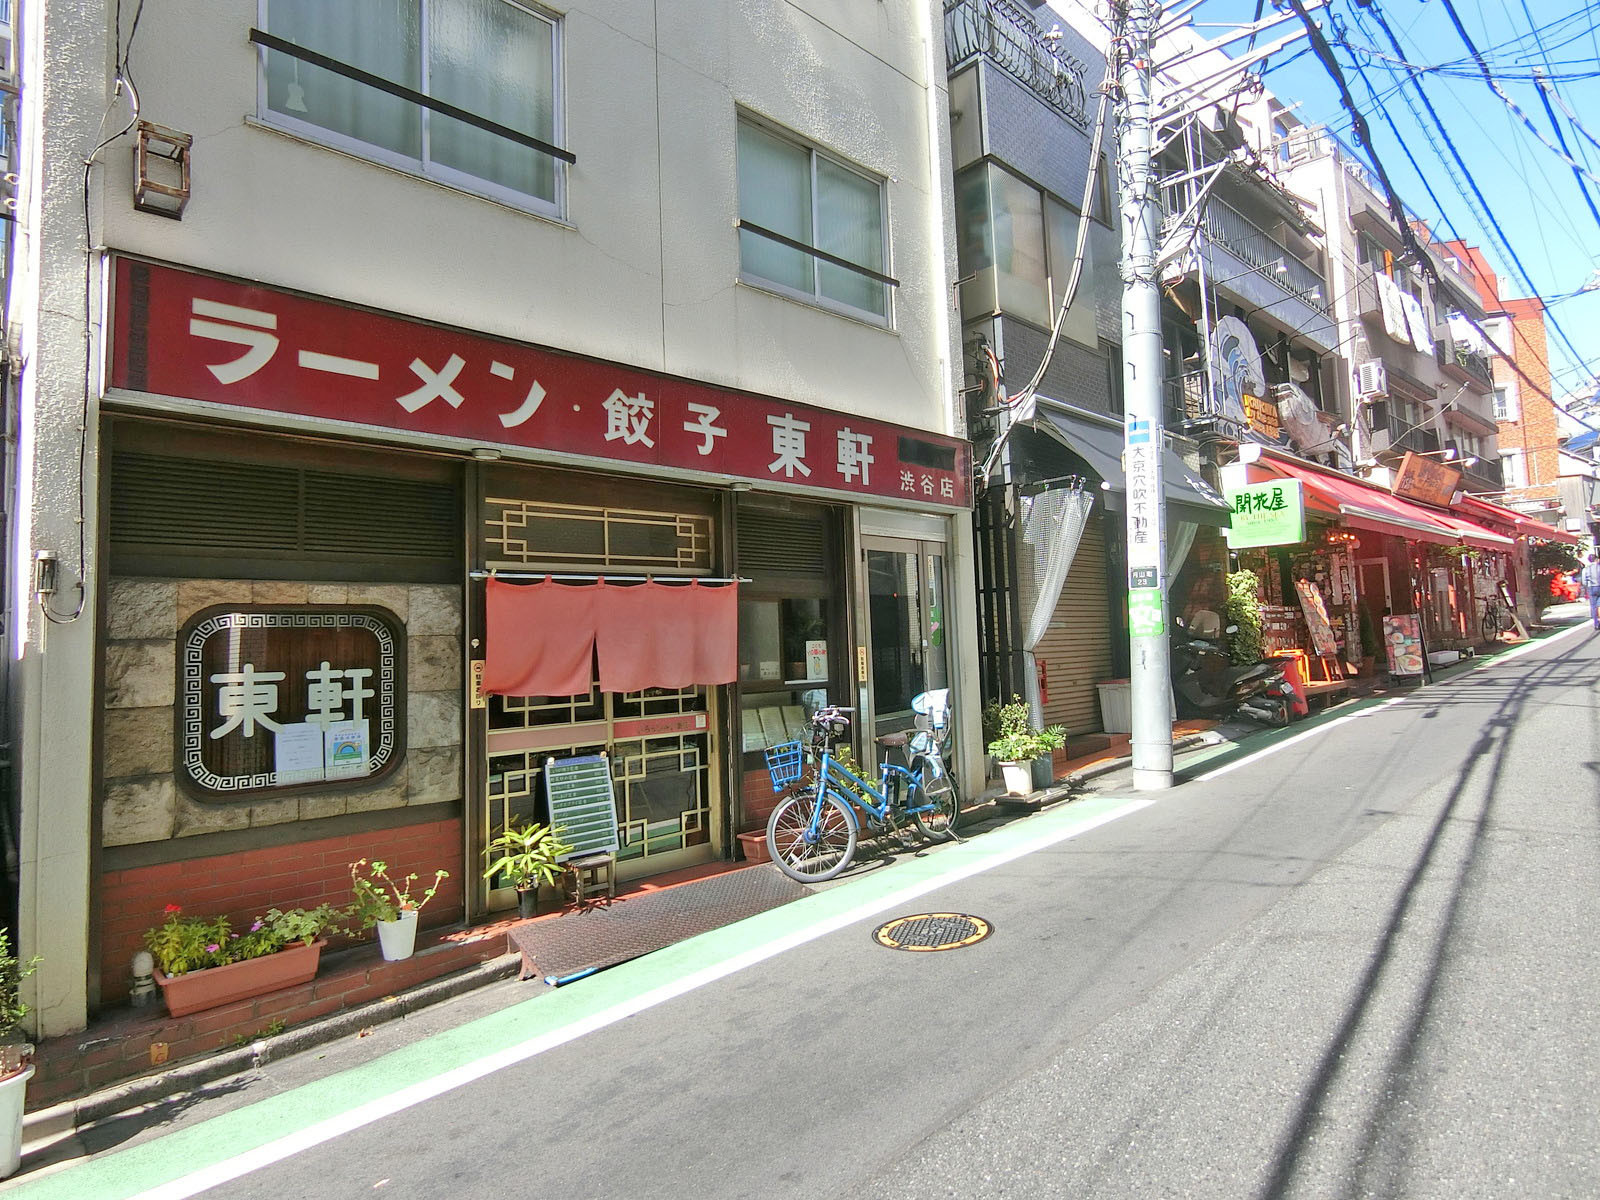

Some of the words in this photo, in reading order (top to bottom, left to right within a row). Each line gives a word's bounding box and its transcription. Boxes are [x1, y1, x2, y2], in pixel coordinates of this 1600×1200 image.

[766, 412, 875, 486] 東軒
[899, 469, 954, 499] 渋谷店
[1132, 447, 1148, 544] 大京穴吹不動産
[209, 660, 376, 740] 東軒
